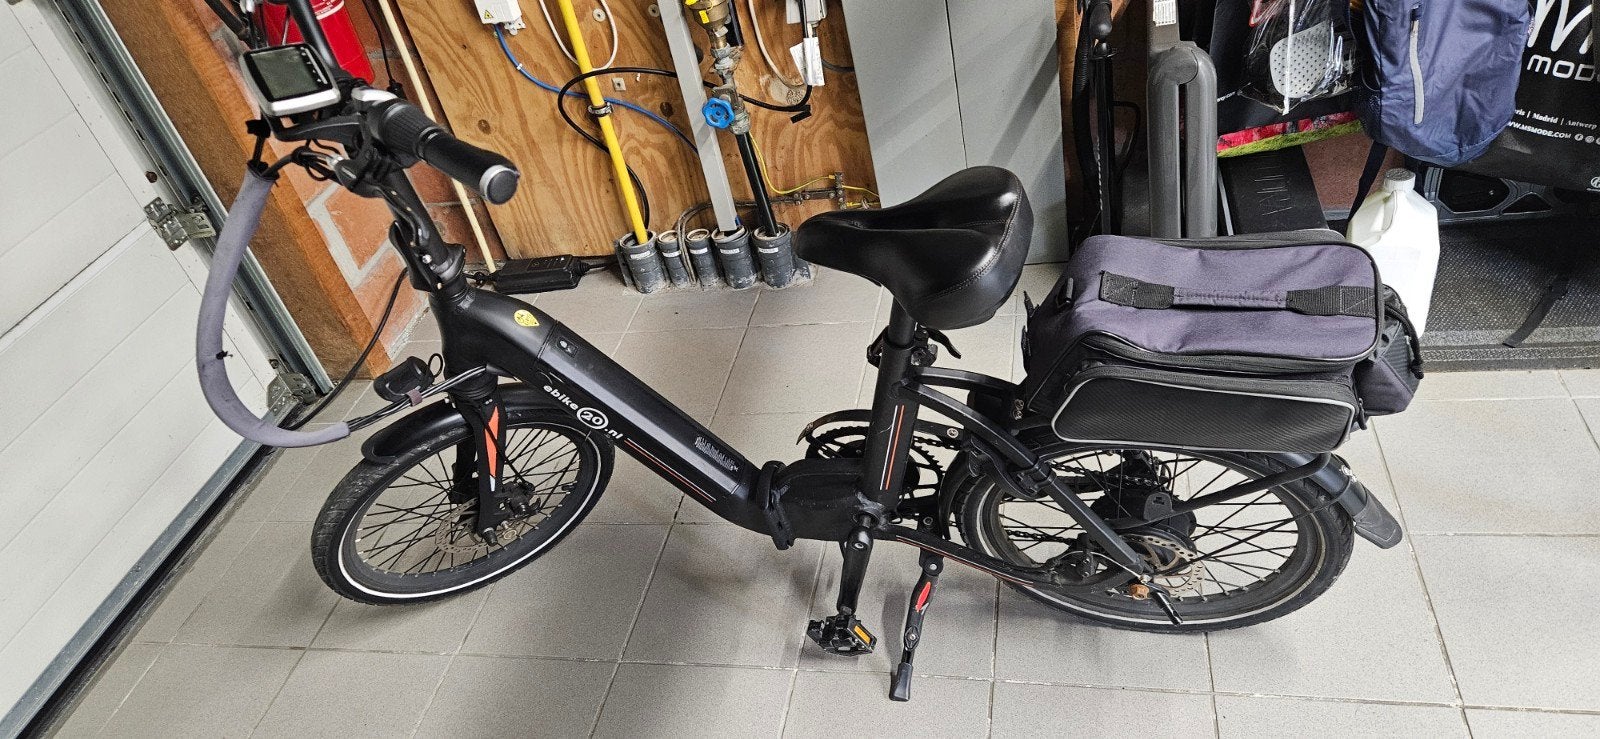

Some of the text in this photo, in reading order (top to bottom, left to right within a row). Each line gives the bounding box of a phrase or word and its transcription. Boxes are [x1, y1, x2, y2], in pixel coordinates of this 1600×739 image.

[1526, 54, 1600, 82] MOD
[1532, 112, 1559, 124] Madrid
[1566, 120, 1597, 130] Antwerp
[543, 385, 579, 410] ebike
